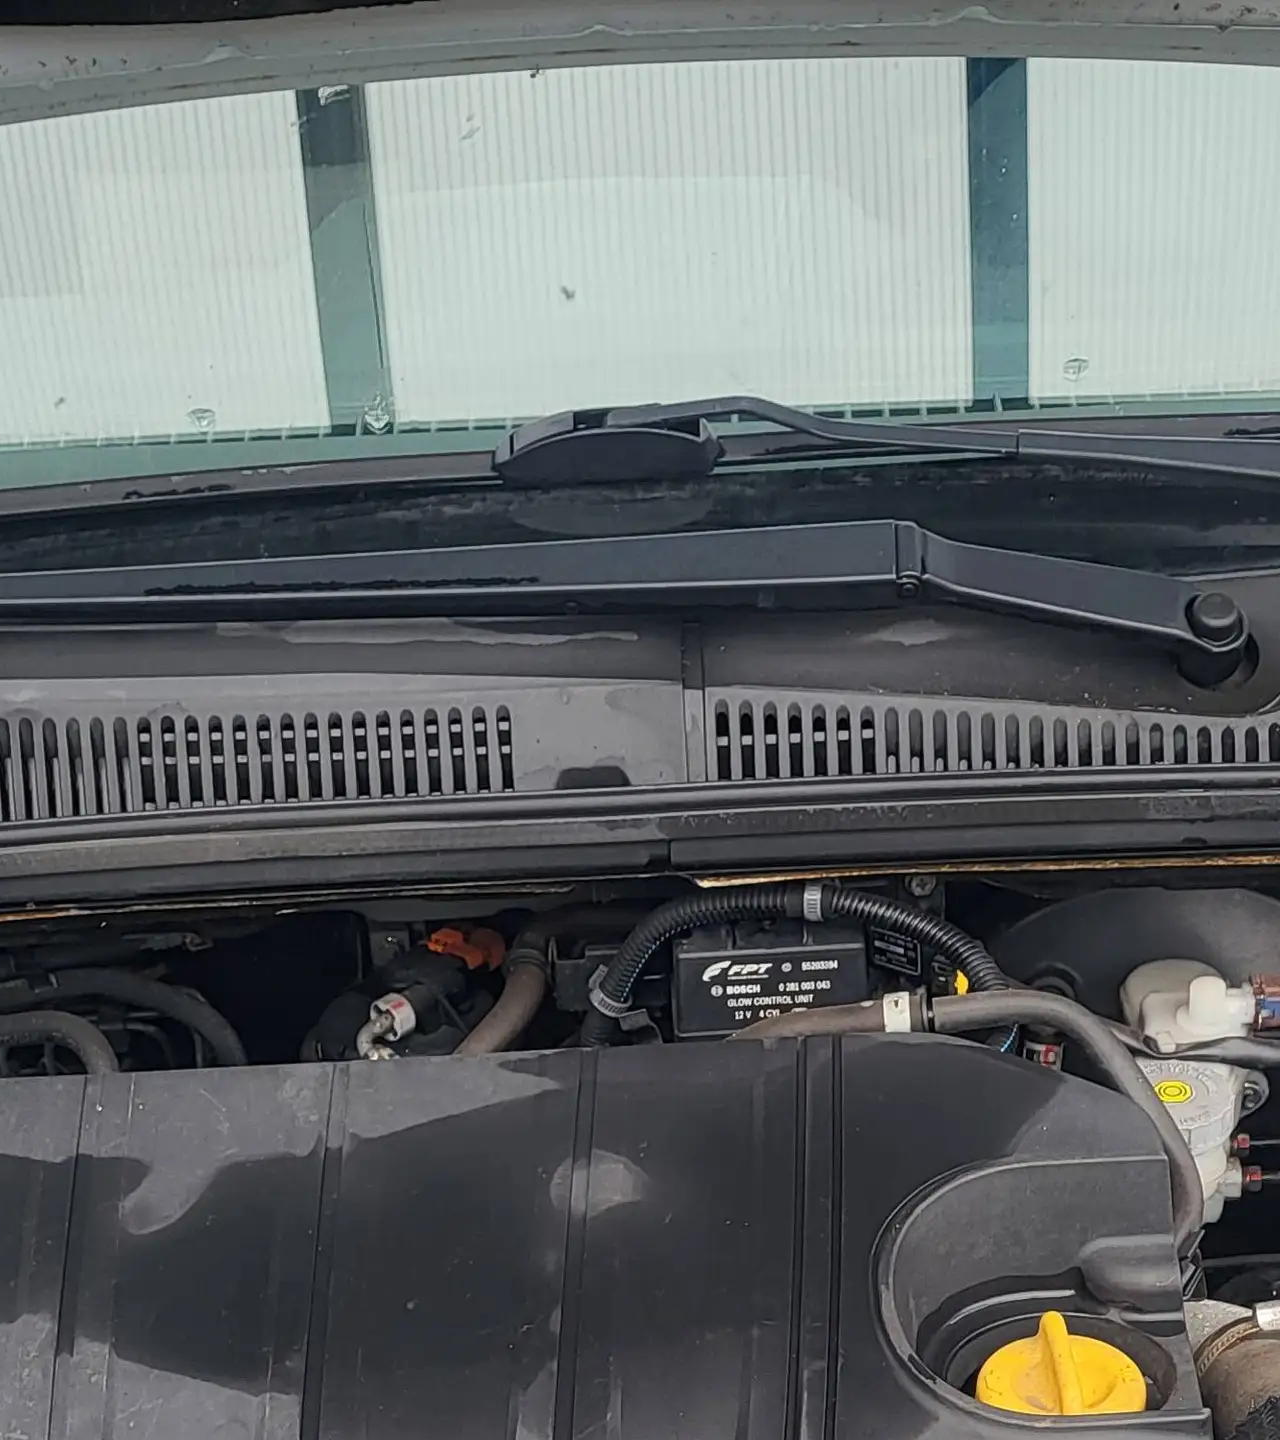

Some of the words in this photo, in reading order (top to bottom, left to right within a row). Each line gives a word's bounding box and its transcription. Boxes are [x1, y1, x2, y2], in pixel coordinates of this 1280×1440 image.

[727, 963, 772, 975] FPT
[726, 985, 761, 994] BOSCH
[779, 982, 785, 992] 0
[727, 998, 752, 1007] GLOW
[754, 996, 792, 1006] CONTROL
[795, 994, 813, 1003] UNIT
[735, 1011, 744, 1020] 12
[745, 1011, 752, 1019] V
[759, 1010, 765, 1018] 4
